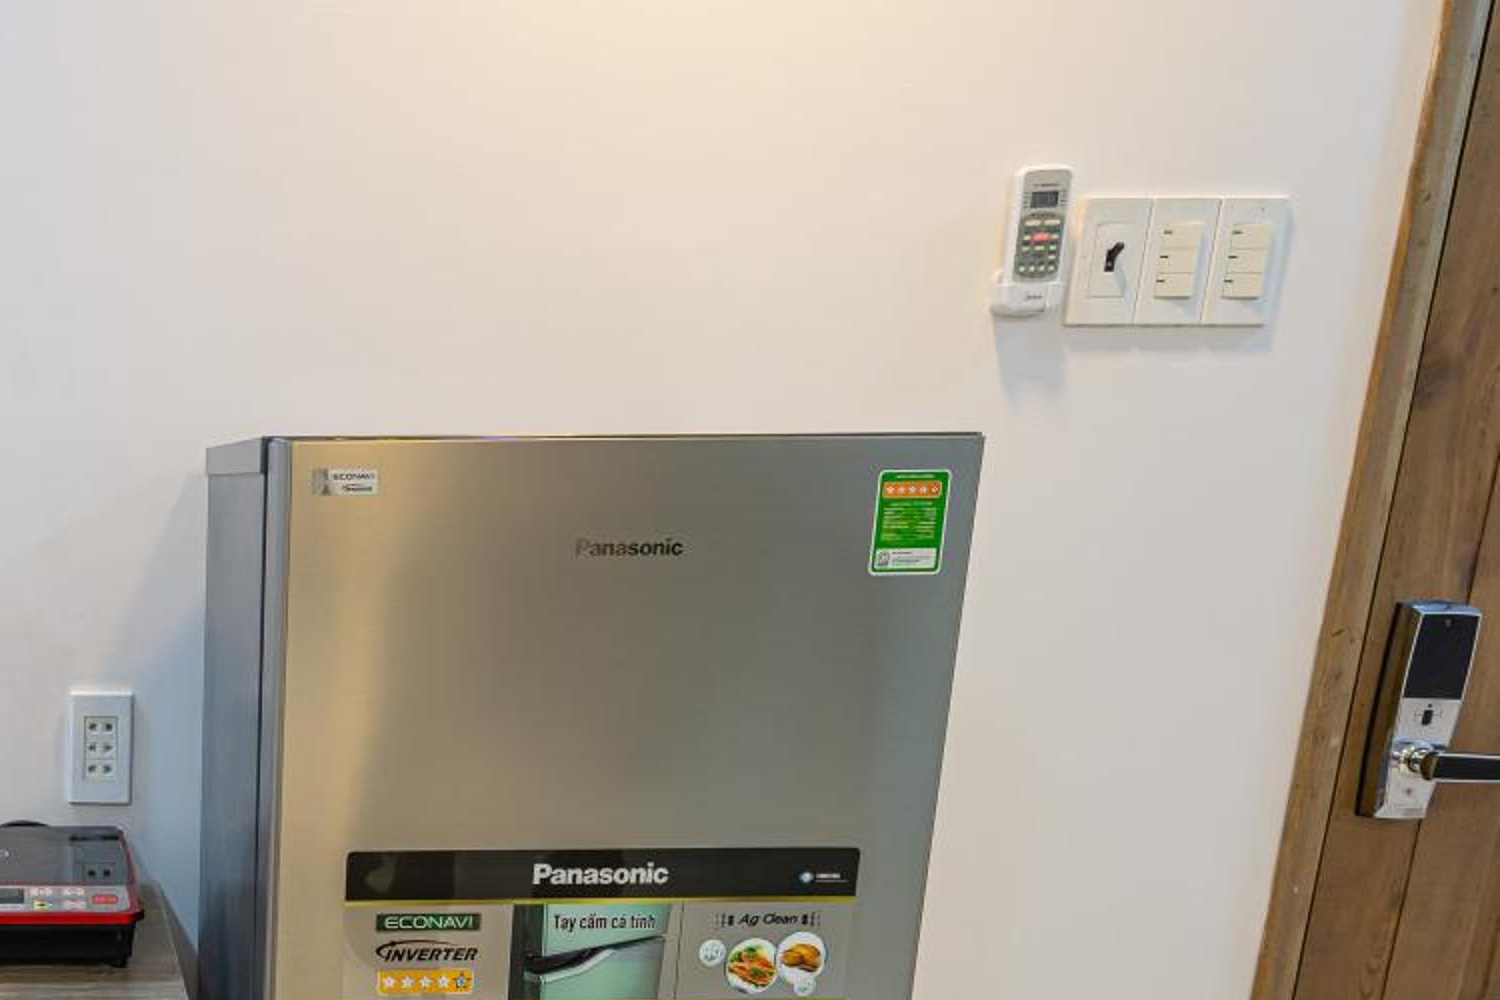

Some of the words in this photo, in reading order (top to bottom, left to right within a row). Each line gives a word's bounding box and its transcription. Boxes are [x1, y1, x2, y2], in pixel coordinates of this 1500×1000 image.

[575, 537, 684, 557] Panasonic
[532, 861, 669, 885] Panasonic
[384, 915, 474, 929] ECONAVI
[554, 913, 577, 933] Tay
[630, 913, 656, 929] tính
[738, 913, 760, 927] Ag
[763, 911, 799, 925] Clean
[383, 947, 479, 962] INVERTER
